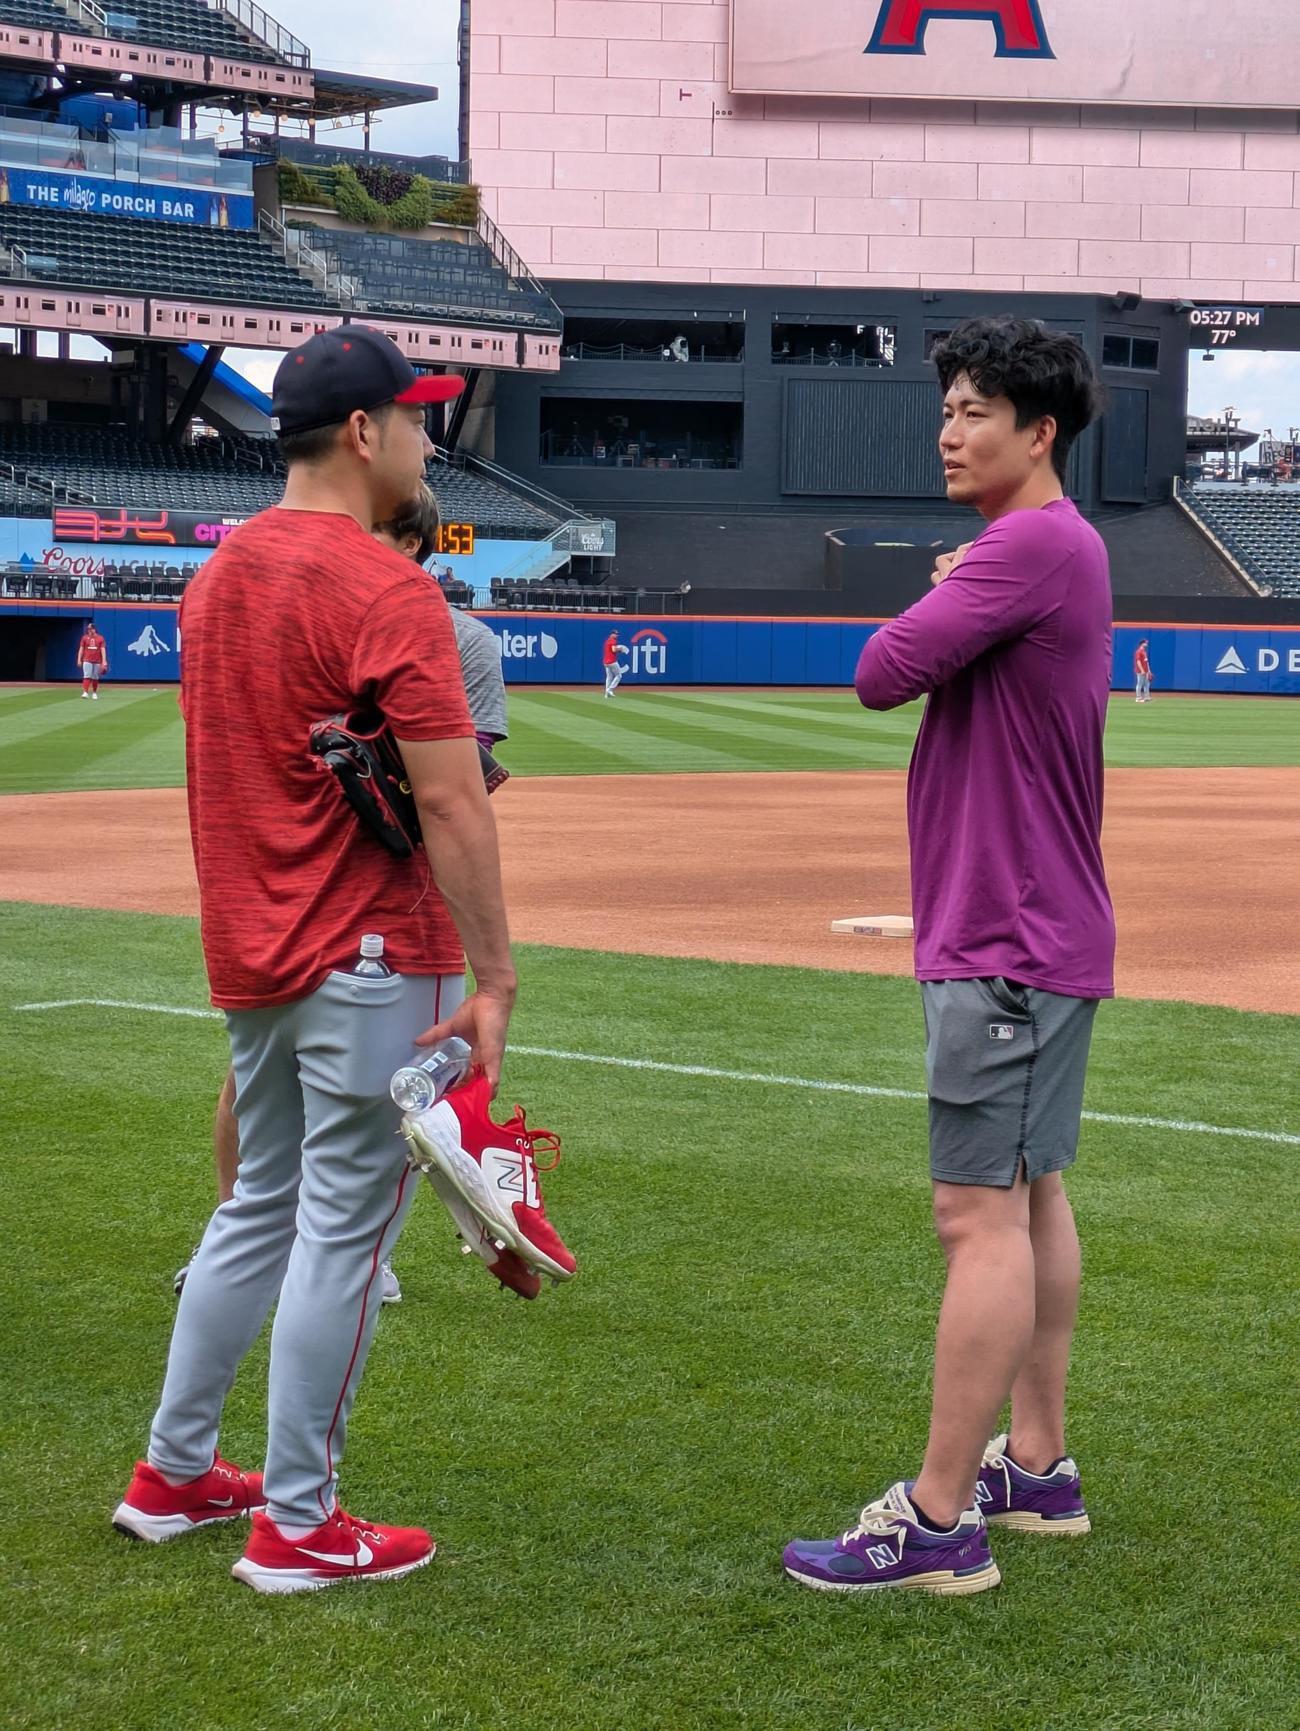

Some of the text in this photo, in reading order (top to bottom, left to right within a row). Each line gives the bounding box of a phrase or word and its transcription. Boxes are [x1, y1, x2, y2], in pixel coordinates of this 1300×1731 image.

[27, 176, 195, 218] THE milagro PORCH BAR
[1190, 310, 1260, 326] 05:27 PM
[1211, 329, 1237, 344] 77°
[43, 547, 105, 576] Coors
[1258, 648, 1300, 672] DE
[865, 1543, 899, 1569] N
